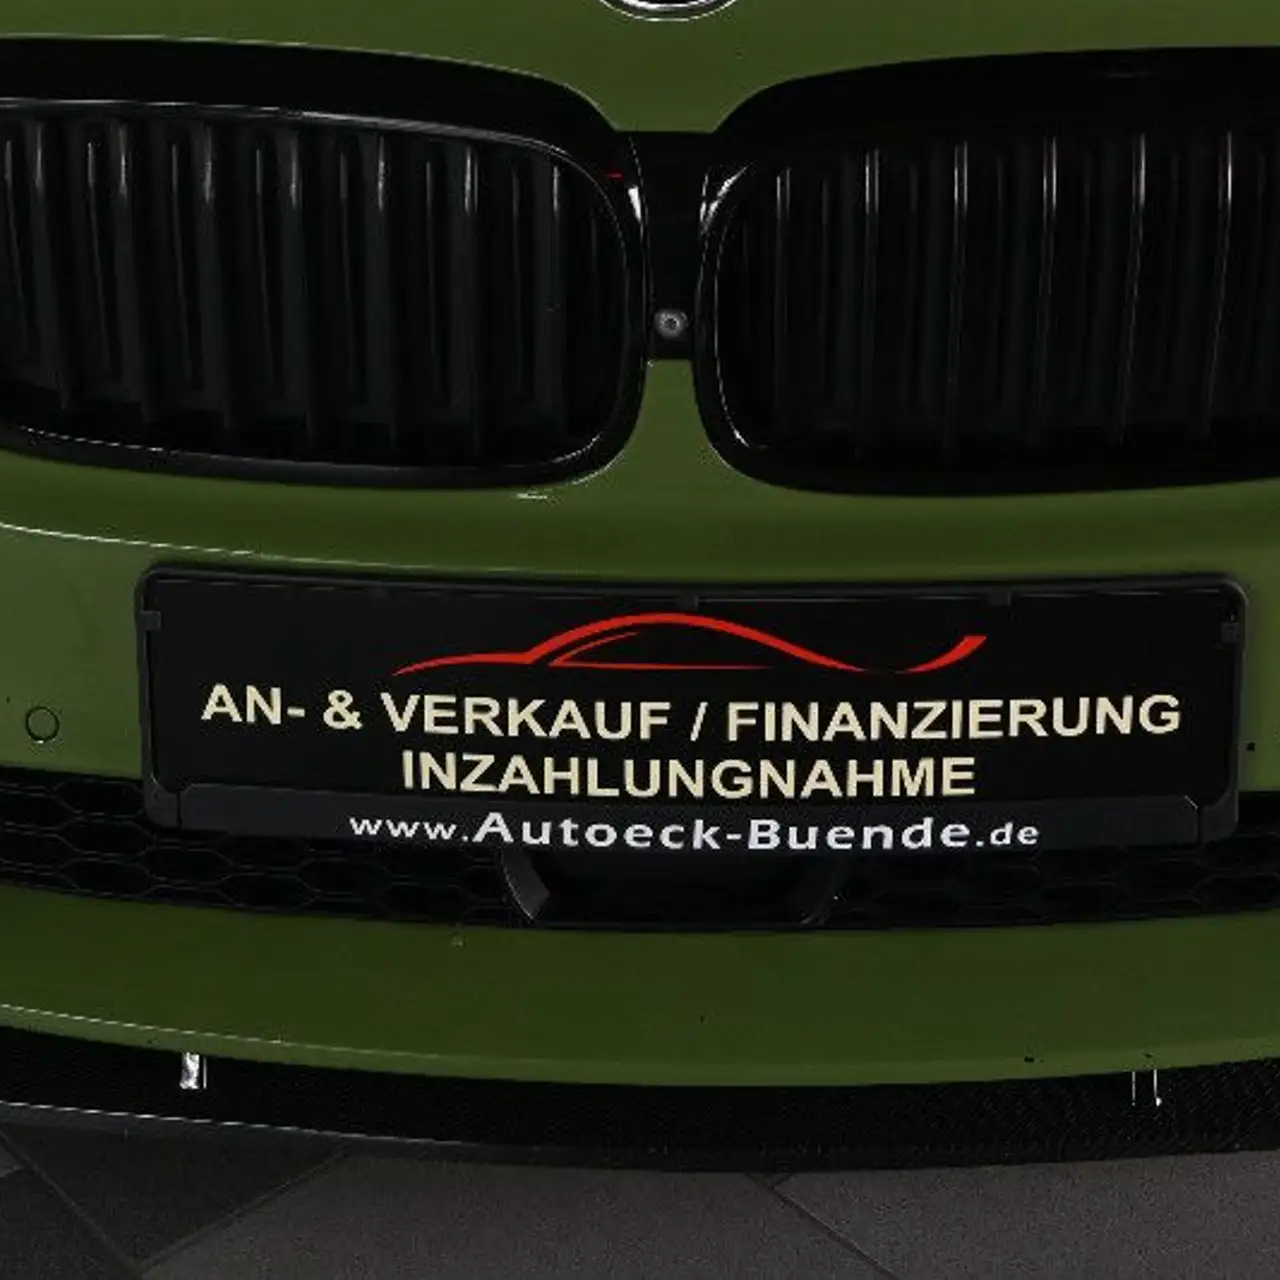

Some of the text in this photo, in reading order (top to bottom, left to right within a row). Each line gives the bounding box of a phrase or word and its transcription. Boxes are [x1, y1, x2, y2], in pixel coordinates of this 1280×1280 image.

[200, 683, 1181, 742] AN- & VERKAUF / FINANZIERUNG
[402, 749, 976, 799] INZAHLUNGNAHME
[349, 811, 1040, 850] www.Autoeck-Buende.de
